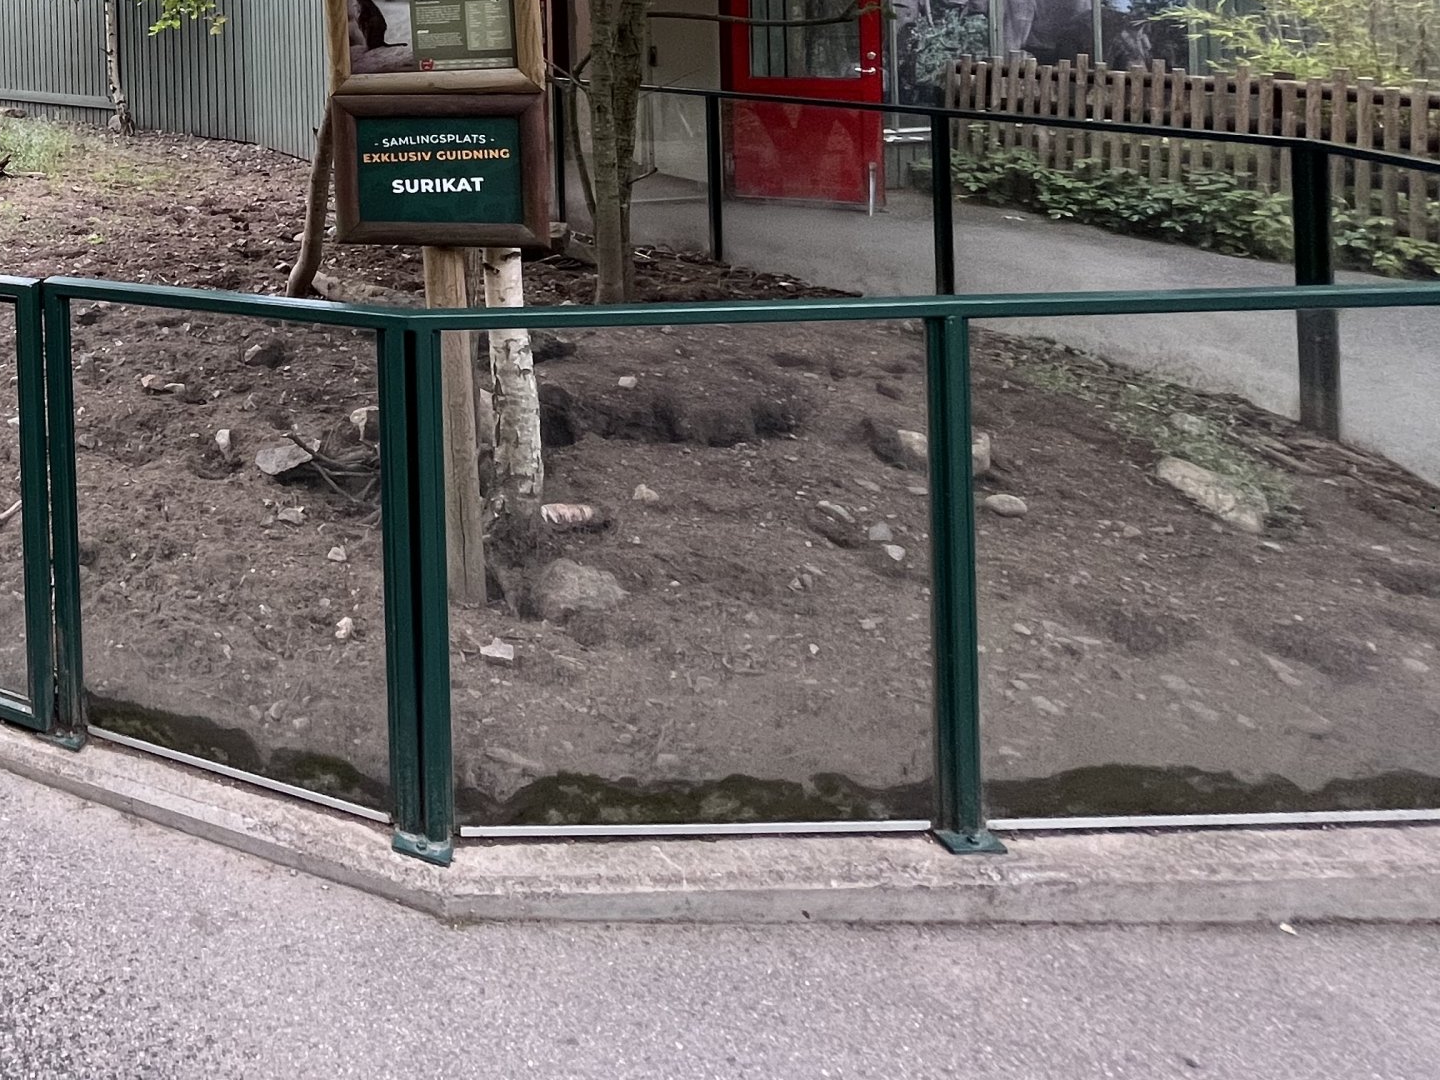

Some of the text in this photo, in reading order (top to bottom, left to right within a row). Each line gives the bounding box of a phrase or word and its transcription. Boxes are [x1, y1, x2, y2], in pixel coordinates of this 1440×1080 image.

[382, 134, 486, 148] SAMLINGSPLATS
[363, 148, 510, 163] EXKLUSIV GUIDNING
[392, 177, 484, 194] SURIKAT
